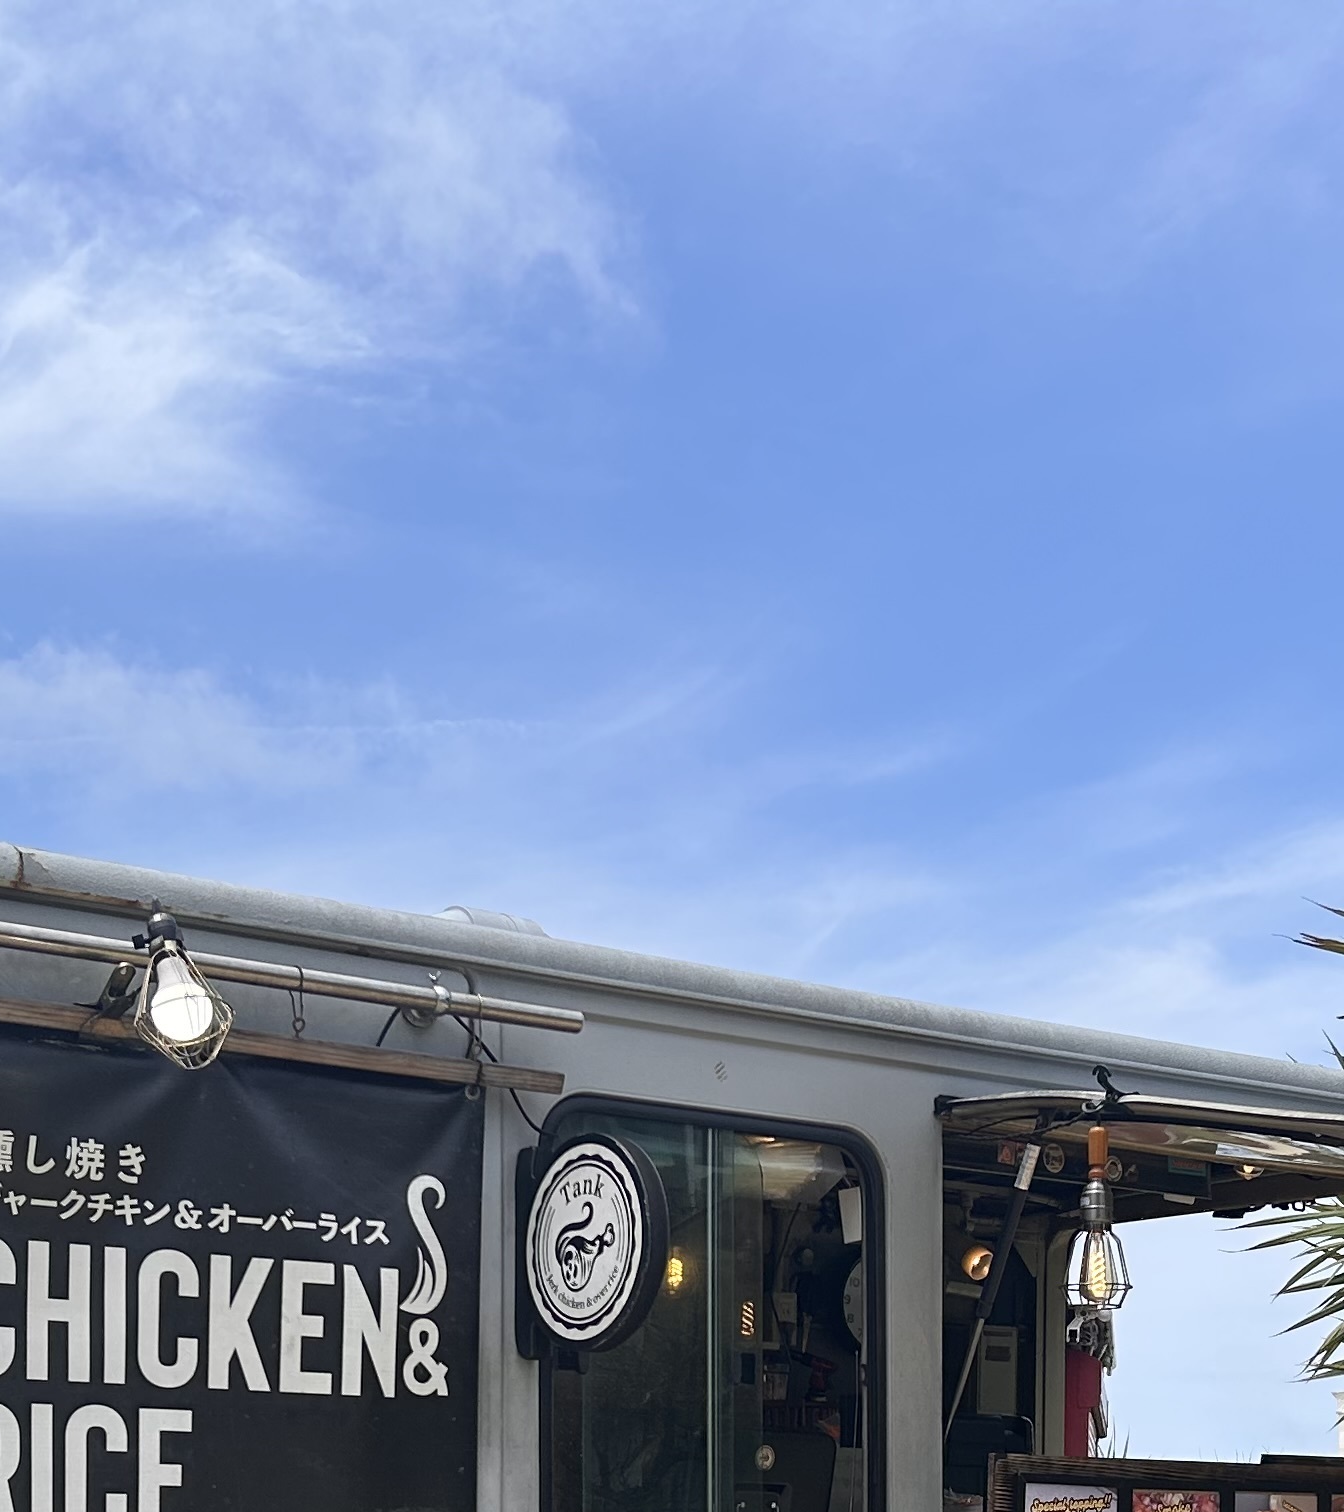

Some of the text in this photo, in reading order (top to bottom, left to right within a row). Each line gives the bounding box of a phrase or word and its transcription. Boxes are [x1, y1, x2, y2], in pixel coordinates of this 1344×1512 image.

[559, 1173, 605, 1206] Tank
[608, 1265, 619, 1287] rice
[403, 1317, 449, 1397] &
